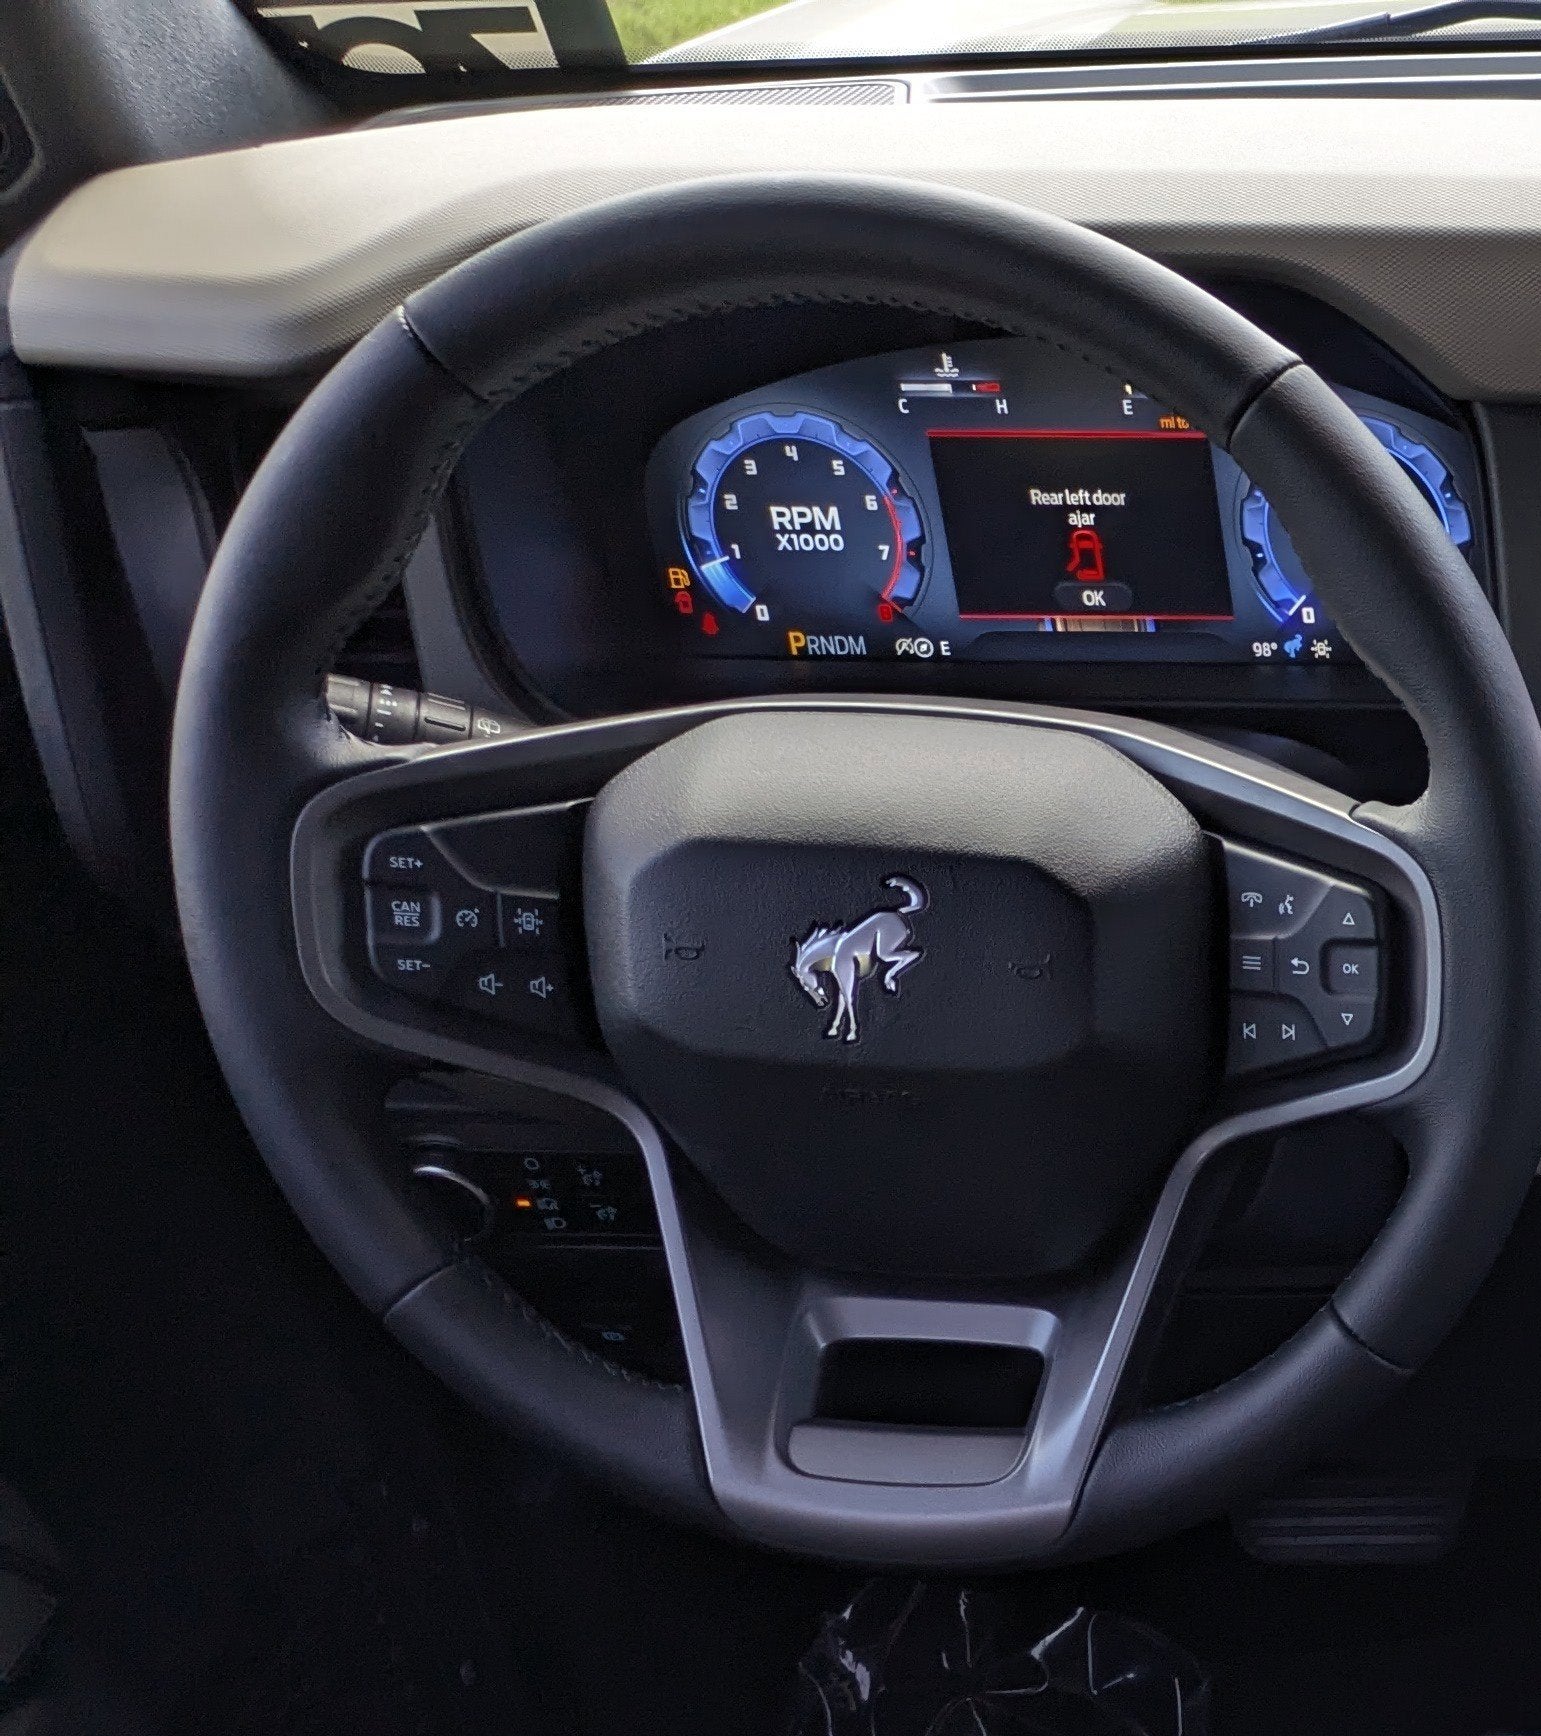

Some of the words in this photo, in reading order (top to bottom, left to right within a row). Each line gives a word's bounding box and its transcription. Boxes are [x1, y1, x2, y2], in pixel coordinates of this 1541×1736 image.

[898, 399, 909, 414] C
[996, 399, 1008, 414] H
[1122, 400, 1133, 415] E
[785, 446, 799, 461] 4
[744, 460, 757, 475] 3
[832, 460, 845, 475] 5
[724, 494, 738, 510] 2
[865, 495, 878, 510] 6
[1030, 489, 1063, 505] Rear
[1065, 489, 1091, 505] left
[1093, 489, 1126, 505] door
[770, 506, 842, 531] RPM
[1068, 511, 1095, 527] ajar
[776, 534, 844, 551] X1000
[731, 545, 741, 559] 1
[878, 545, 889, 561] 7
[1082, 591, 1106, 606] OK
[756, 605, 770, 621] 0
[1301, 606, 1315, 624] 0
[941, 642, 951, 656] E
[389, 856, 423, 869] SET+
[391, 901, 421, 913] CAN
[394, 915, 420, 927] RES
[1342, 963, 1359, 975] OK
